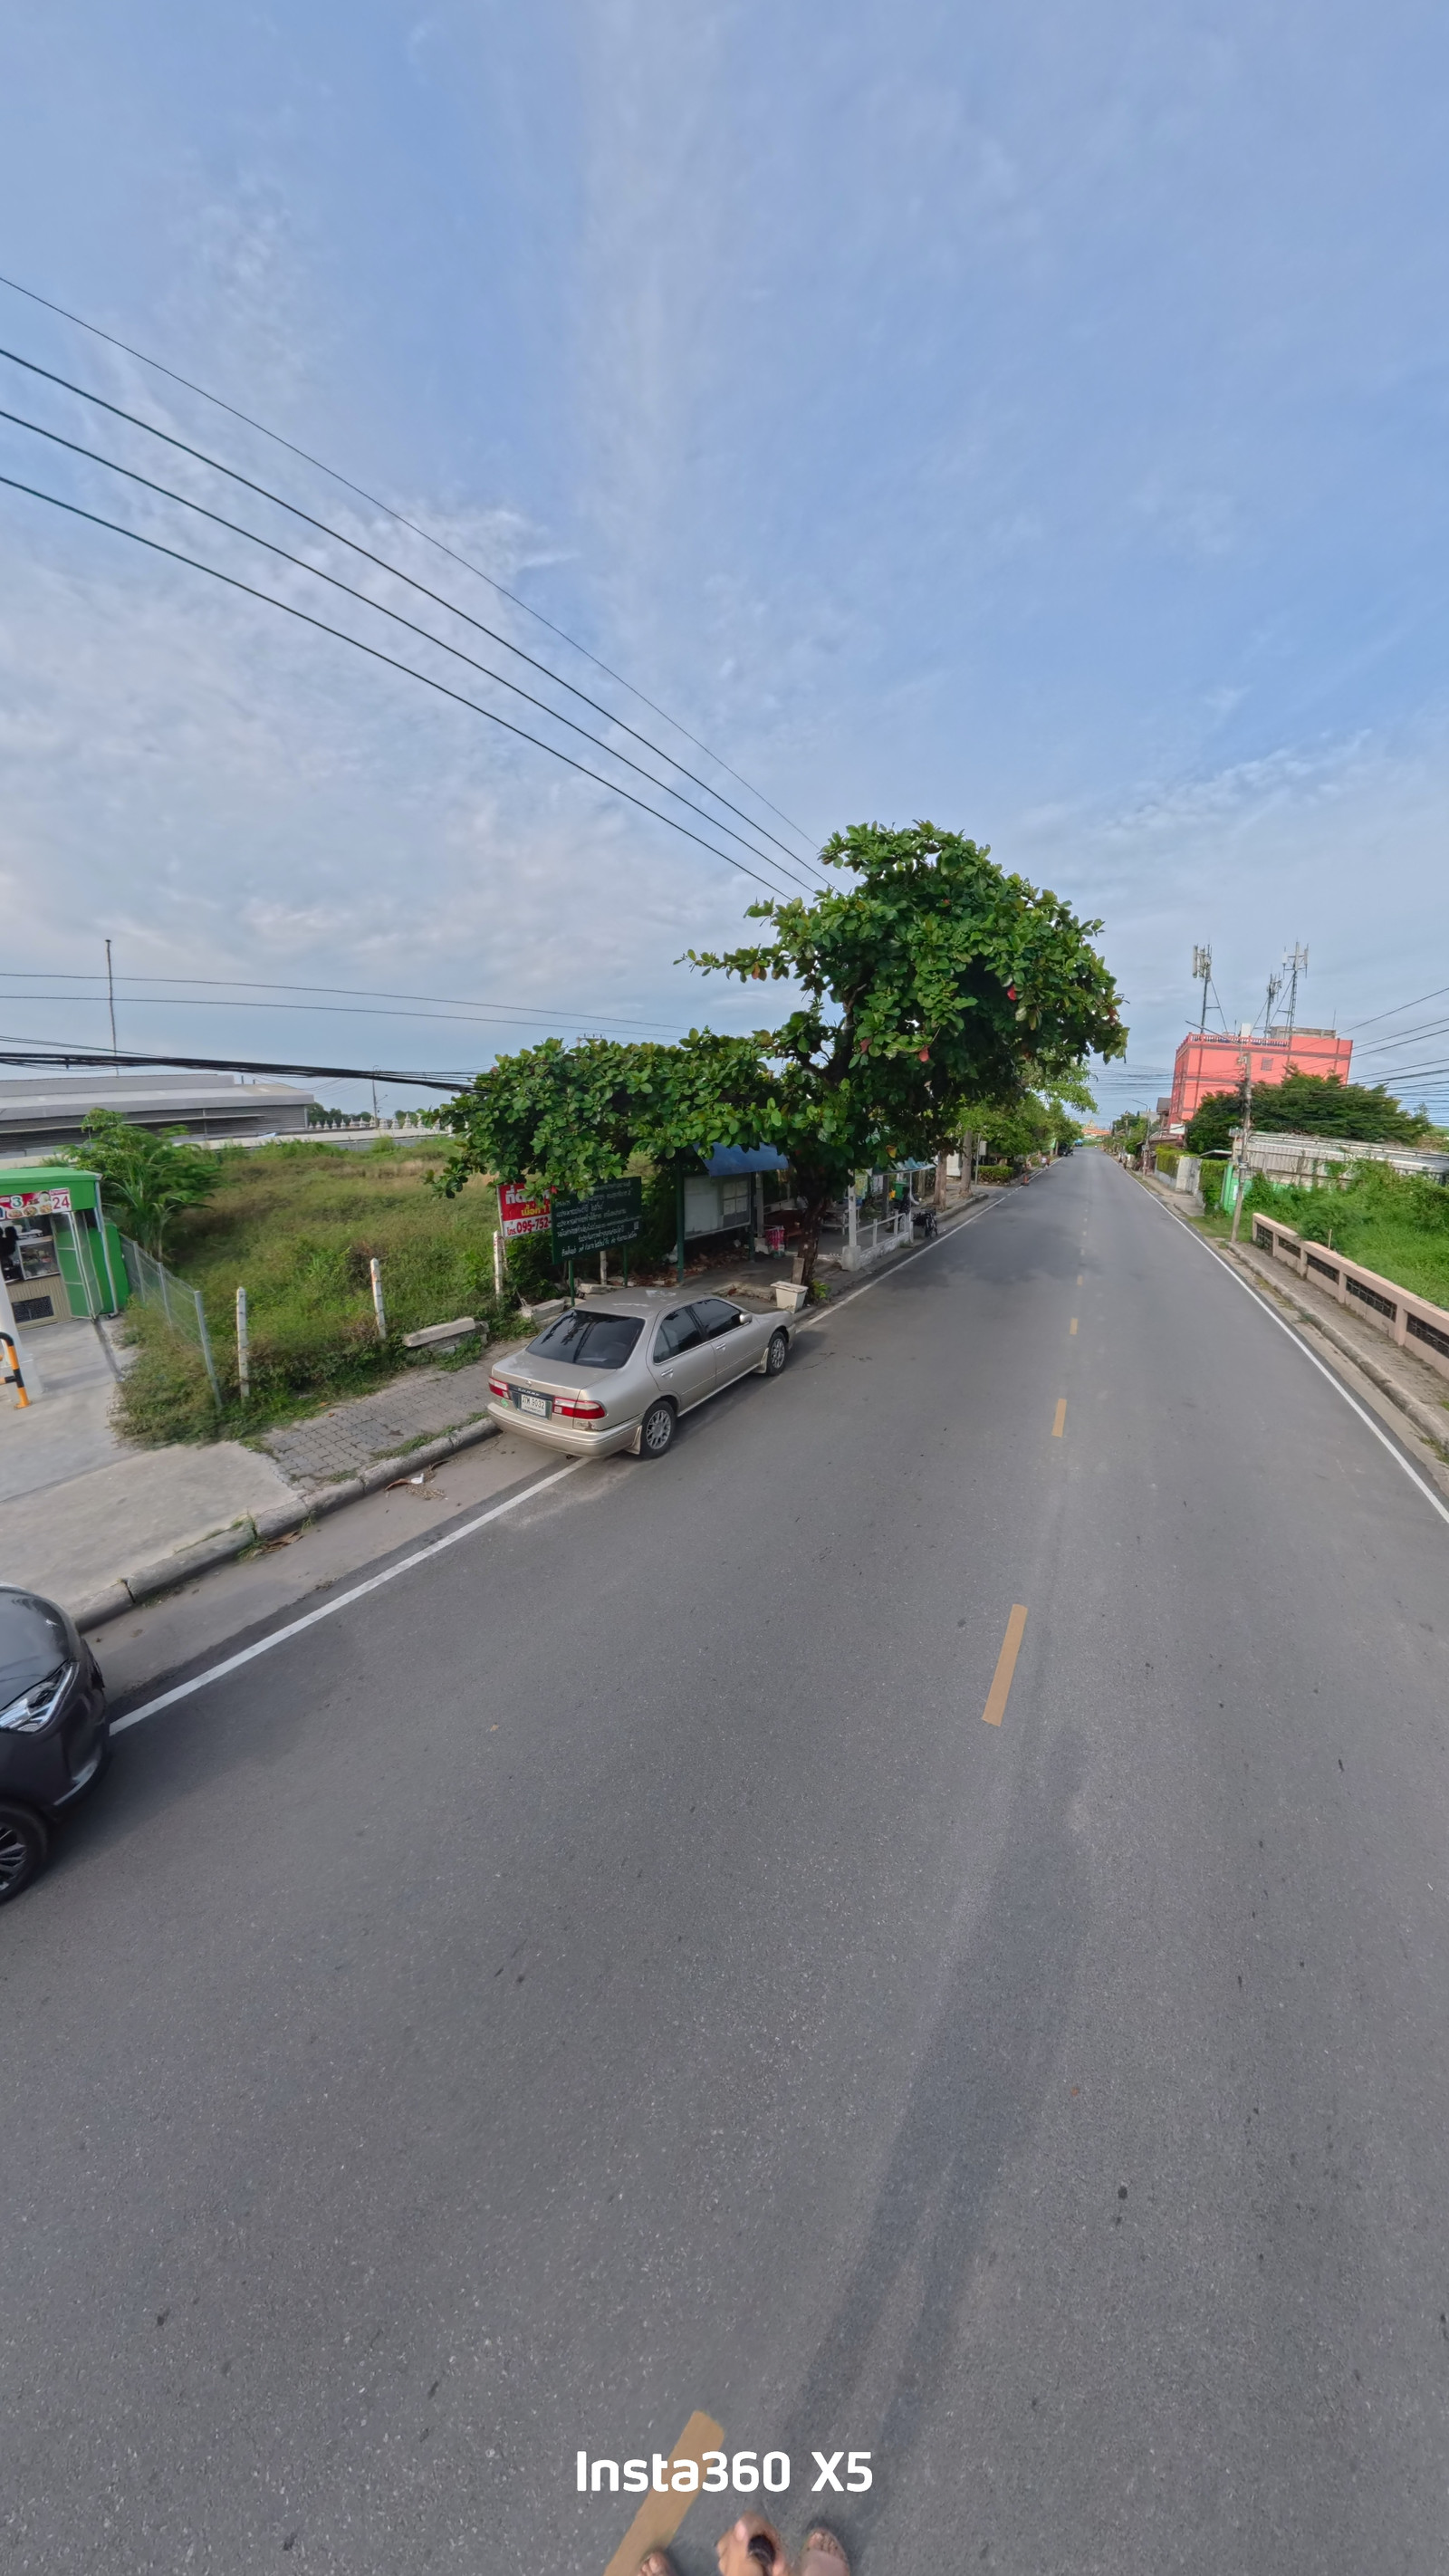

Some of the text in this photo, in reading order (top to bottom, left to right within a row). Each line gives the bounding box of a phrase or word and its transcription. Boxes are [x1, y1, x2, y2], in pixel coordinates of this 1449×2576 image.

[12, 1197, 22, 1207] 3
[53, 1196, 70, 1210] 24
[532, 1398, 545, 1409] 9032
